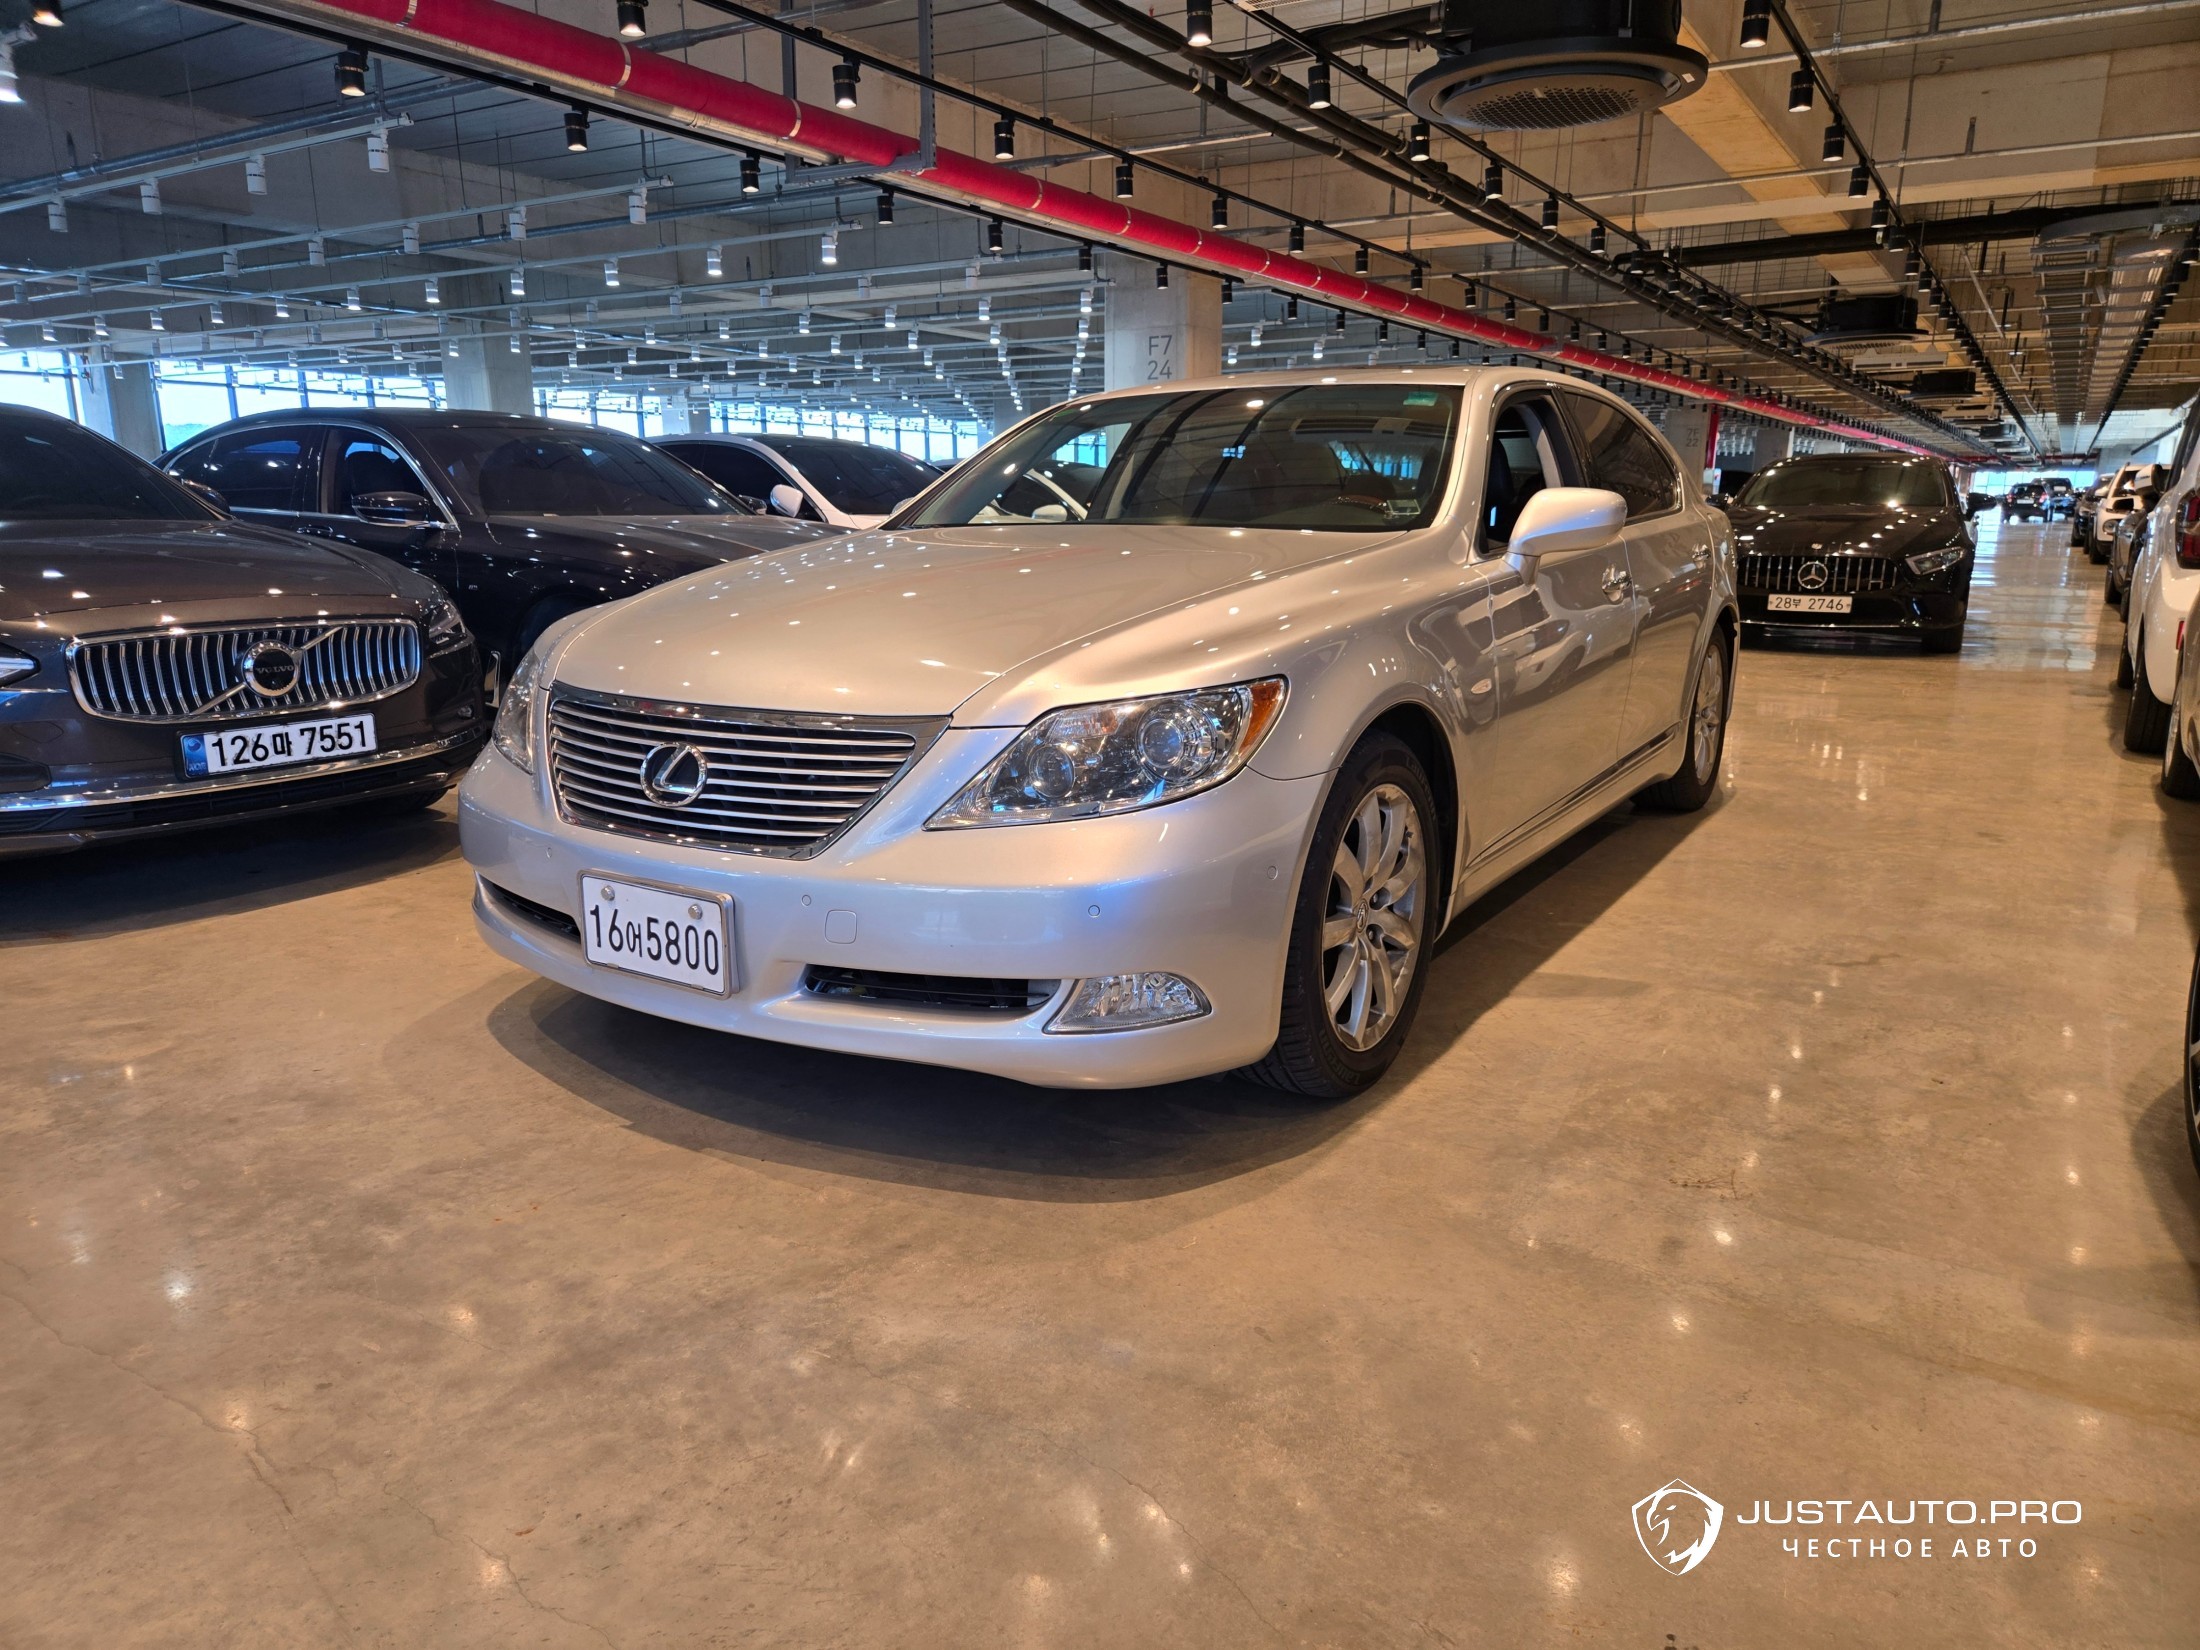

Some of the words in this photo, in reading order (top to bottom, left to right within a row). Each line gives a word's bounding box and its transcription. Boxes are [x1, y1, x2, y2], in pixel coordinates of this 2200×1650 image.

[1148, 335, 1173, 356] F7
[1147, 360, 1173, 380] 24
[1808, 598, 1844, 611] 2746
[256, 664, 294, 674] VOLVO
[299, 720, 367, 756] 7551
